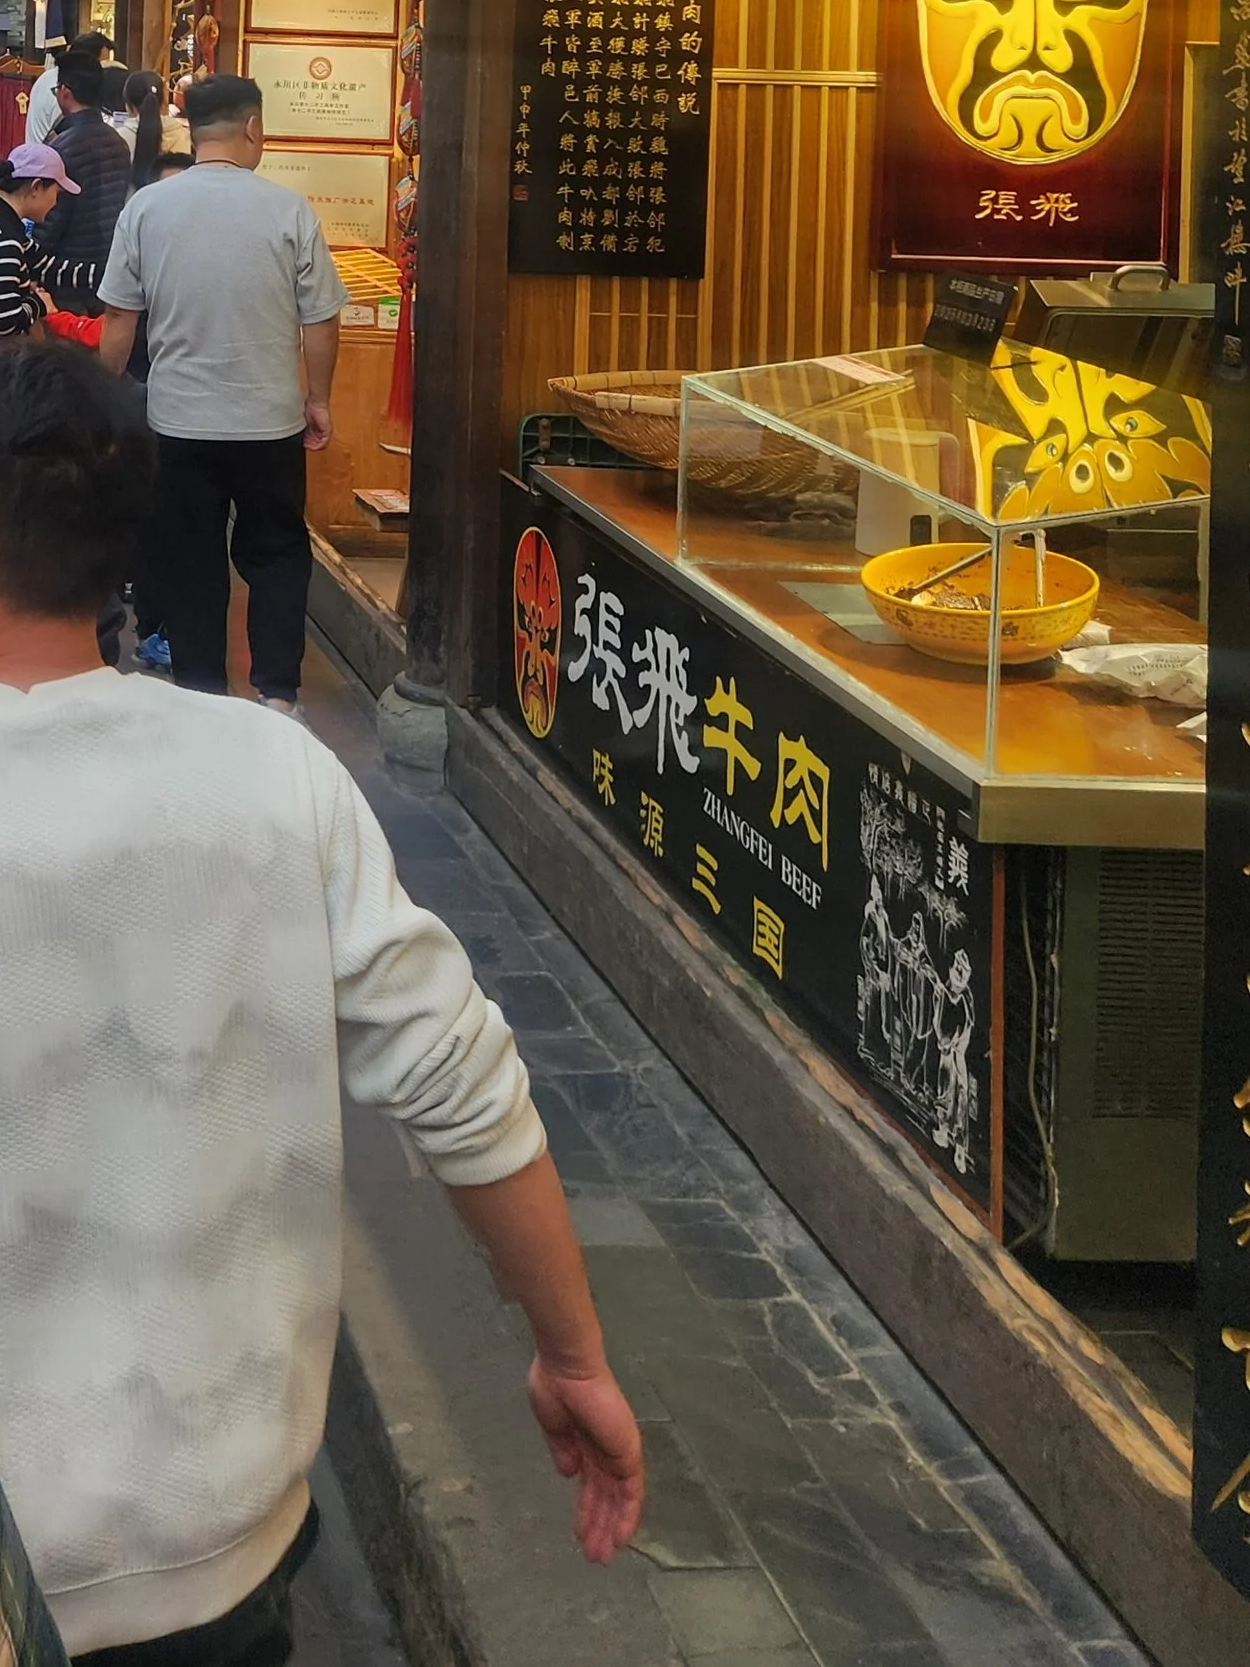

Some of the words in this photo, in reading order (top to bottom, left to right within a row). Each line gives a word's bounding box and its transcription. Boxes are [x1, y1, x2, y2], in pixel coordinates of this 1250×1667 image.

[974, 188, 1079, 227] 張飛
[566, 572, 833, 873] 張飛牛肉
[592, 747, 785, 980] 味源三国
[702, 785, 775, 869] ZHANGFEI
[780, 854, 823, 911] BEEF
